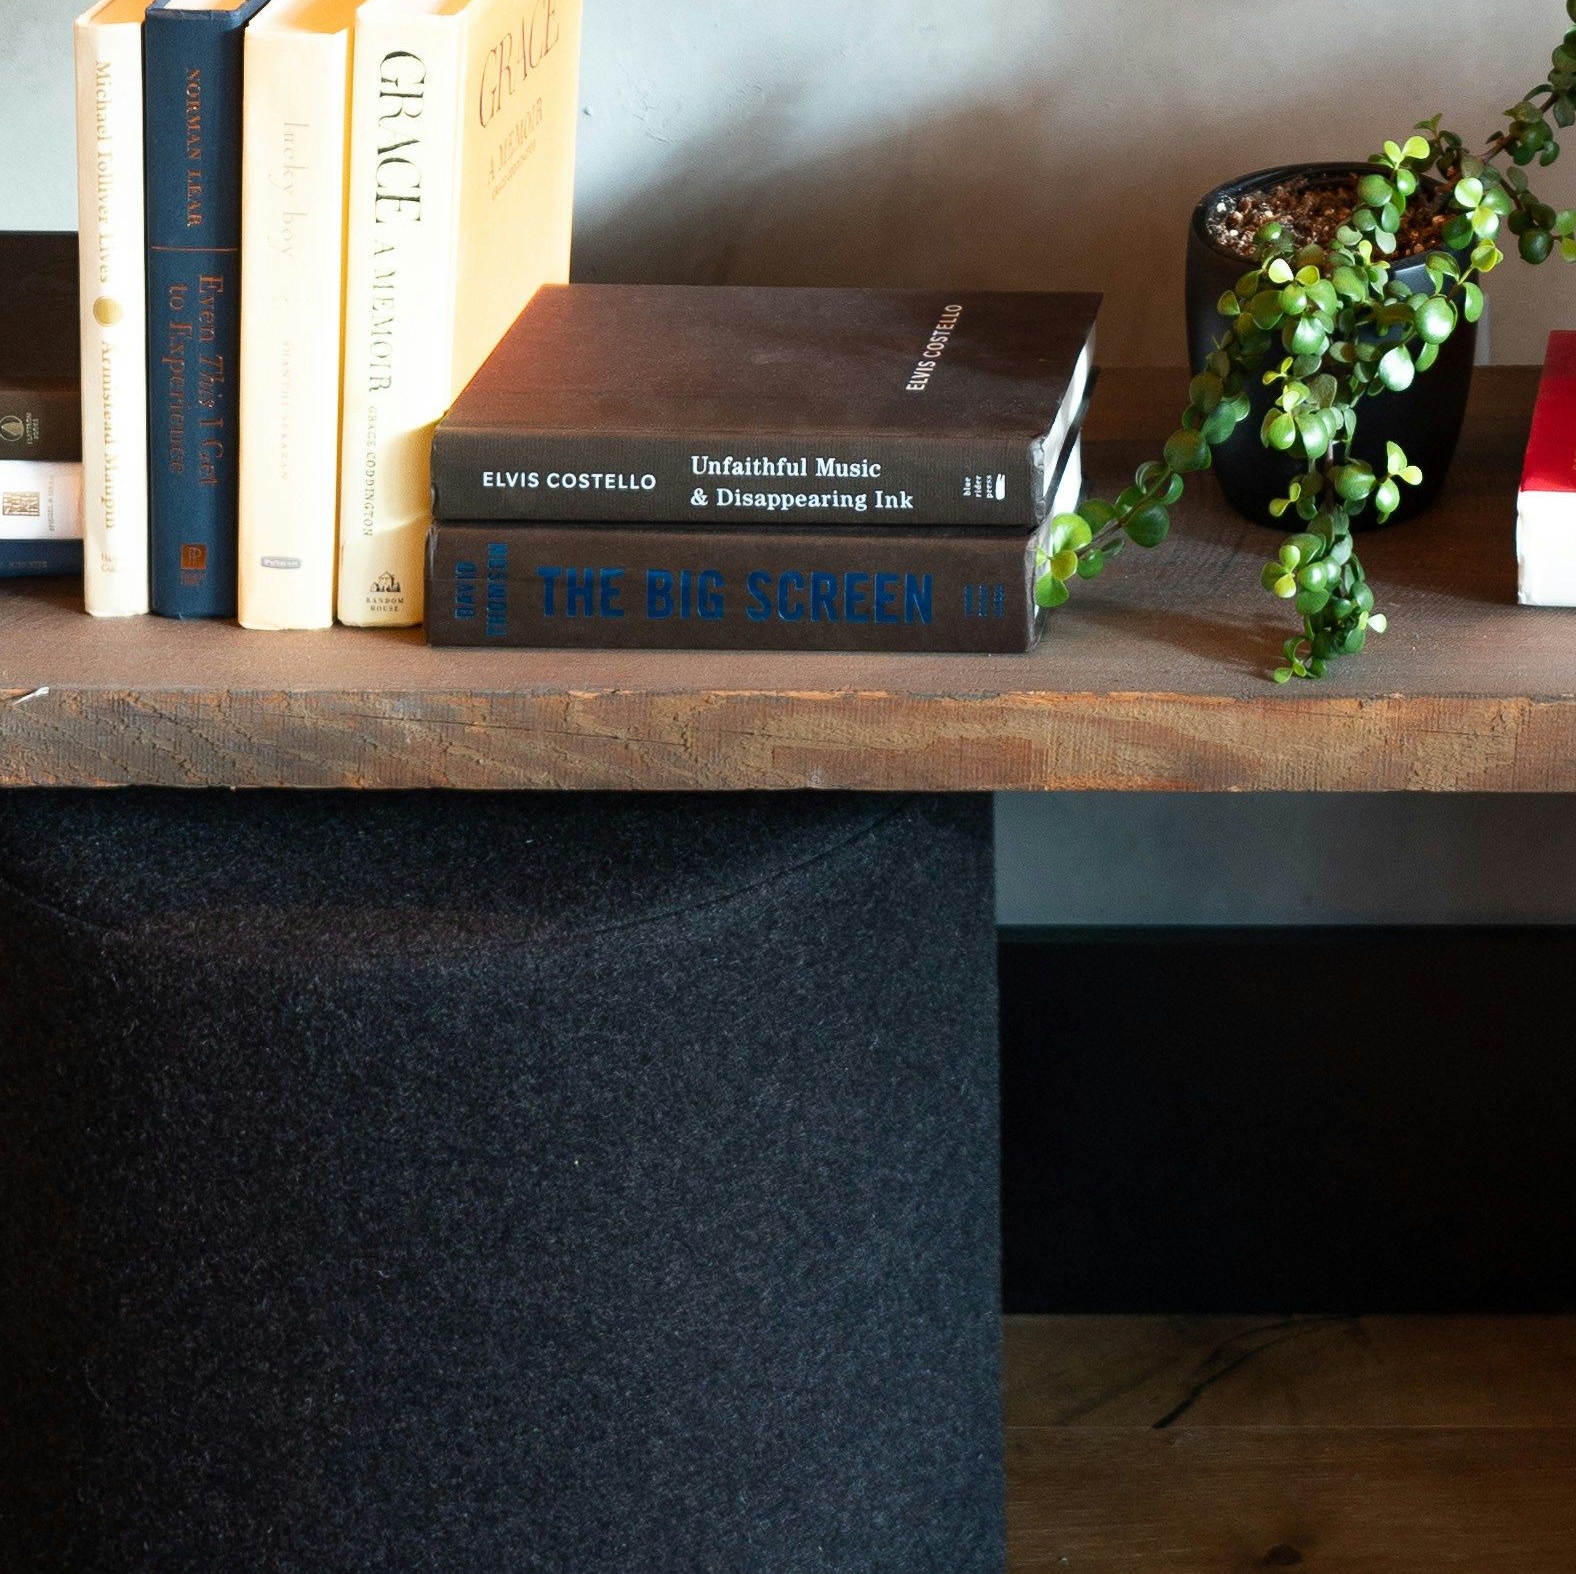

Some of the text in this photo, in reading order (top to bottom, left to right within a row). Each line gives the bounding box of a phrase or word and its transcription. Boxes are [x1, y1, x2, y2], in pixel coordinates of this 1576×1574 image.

[185, 68, 204, 228] NORMAN LEAR
[368, 50, 427, 394] GRACE A MEMOIR
[482, 471, 657, 491] ELVIS COSTELLO
[690, 455, 882, 479] Unfaithful Music
[690, 488, 914, 512] & Disappearing Ink
[455, 561, 478, 619] DAVID
[486, 543, 509, 637] THOMSON
[536, 566, 625, 619] THE
[646, 569, 726, 621] BIG
[745, 570, 934, 626] SCREEN
